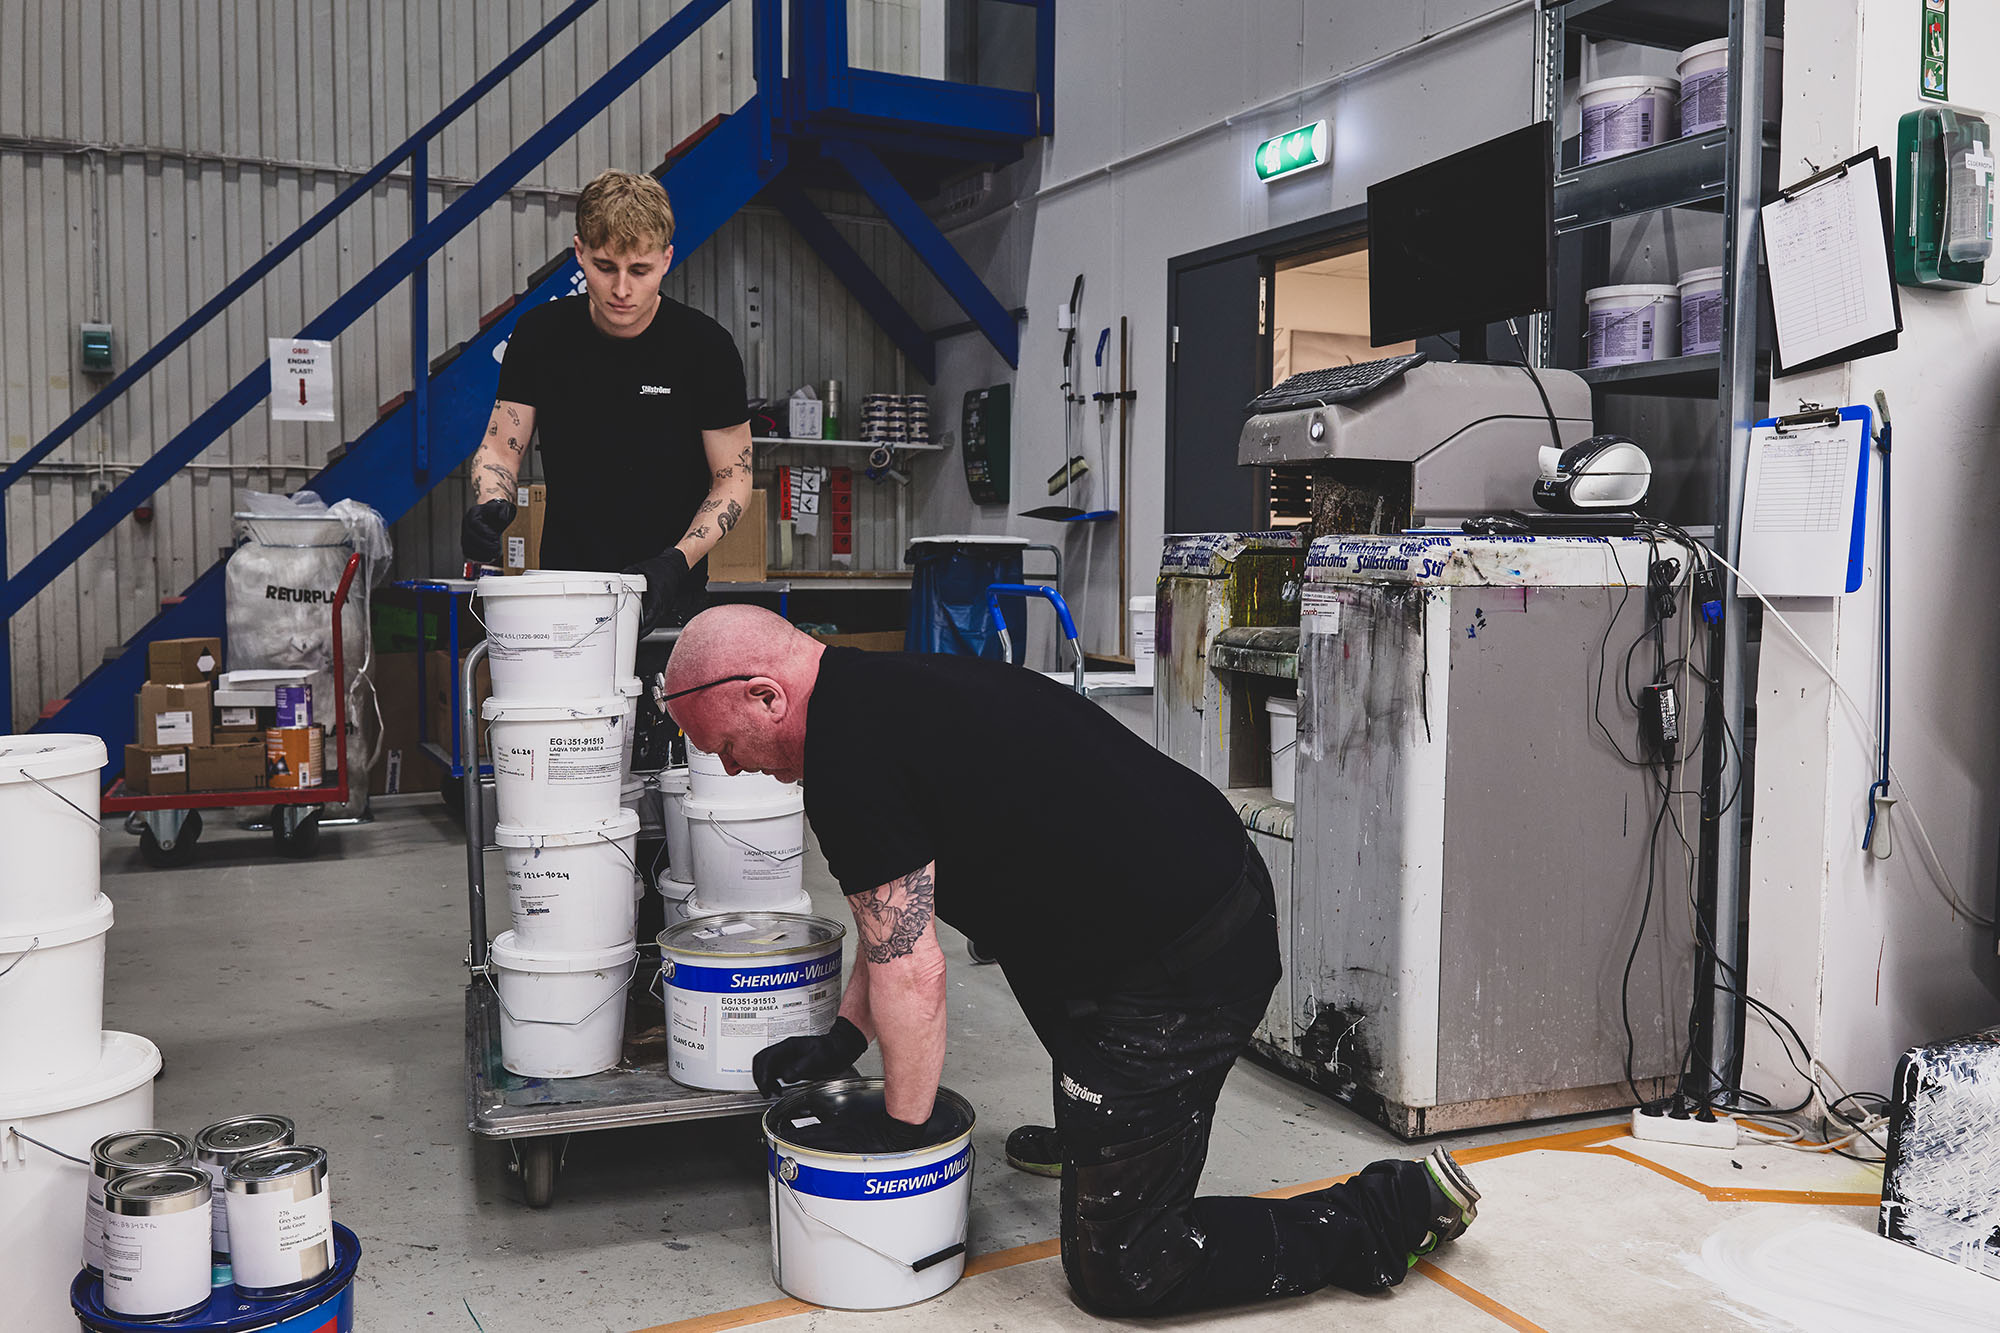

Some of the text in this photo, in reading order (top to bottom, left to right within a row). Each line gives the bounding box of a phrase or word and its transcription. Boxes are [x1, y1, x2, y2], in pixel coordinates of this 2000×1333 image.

[549, 737, 605, 746] EG1351-91513
[523, 870, 570, 881] 1226-9024
[721, 996, 777, 1005] EG1351-91513
[697, 1043, 705, 1051] 20
